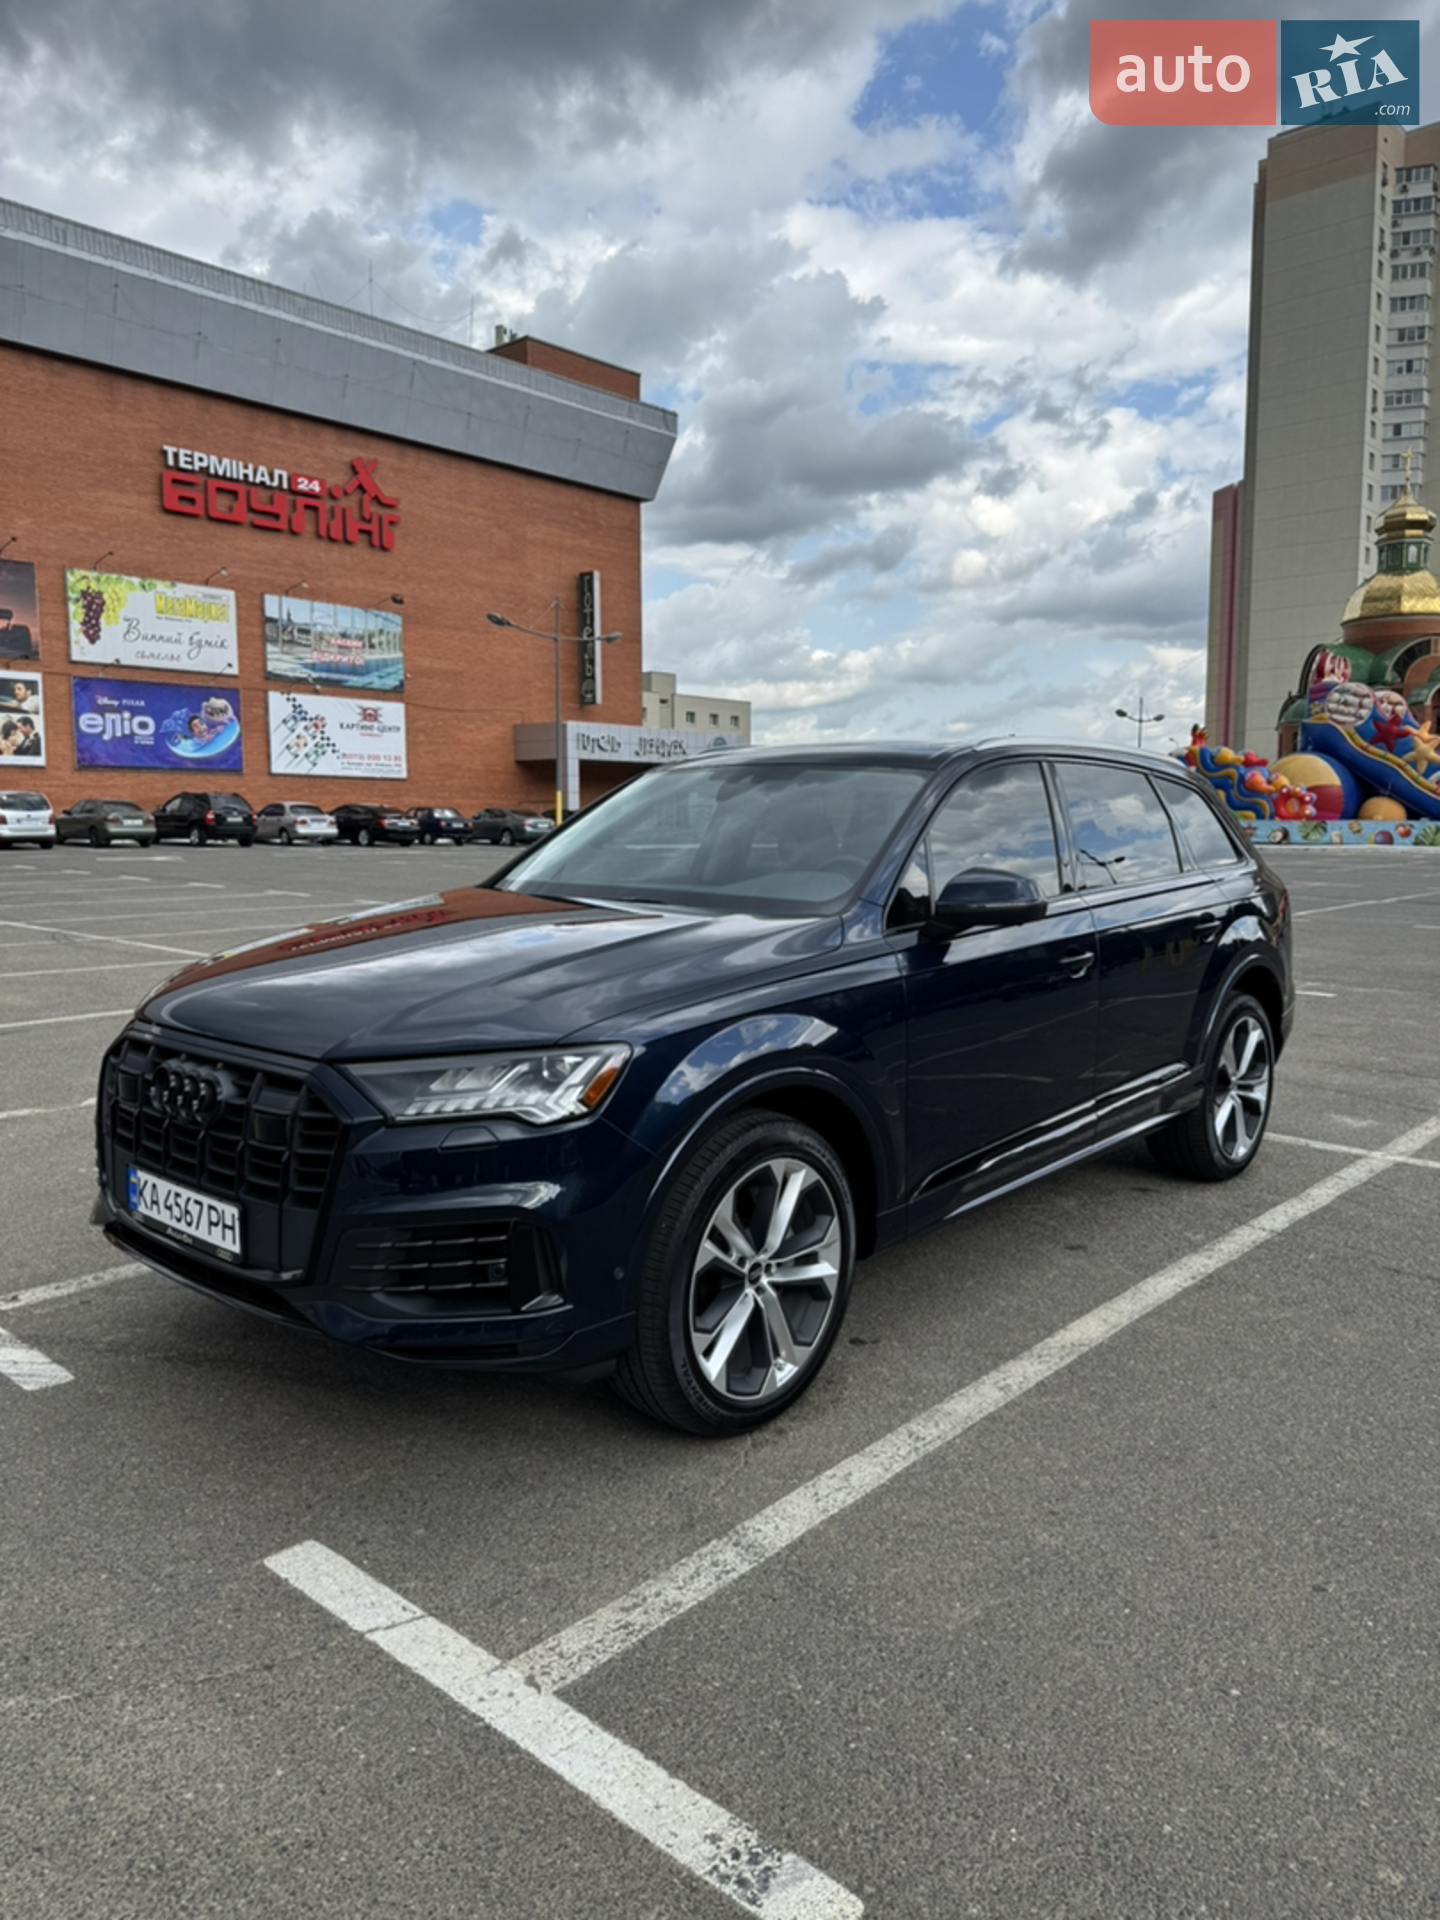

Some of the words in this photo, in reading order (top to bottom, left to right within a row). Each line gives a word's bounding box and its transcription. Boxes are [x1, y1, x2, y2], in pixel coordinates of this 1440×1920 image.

[162, 444, 289, 490] ТЕРМІНАЛ
[297, 477, 321, 493] 24
[162, 469, 401, 551] БОУЛІНГ
[121, 698, 146, 708] PIXAR
[138, 1176, 161, 1215] KA
[164, 1188, 204, 1231] 4567
[207, 1203, 237, 1246] PH
